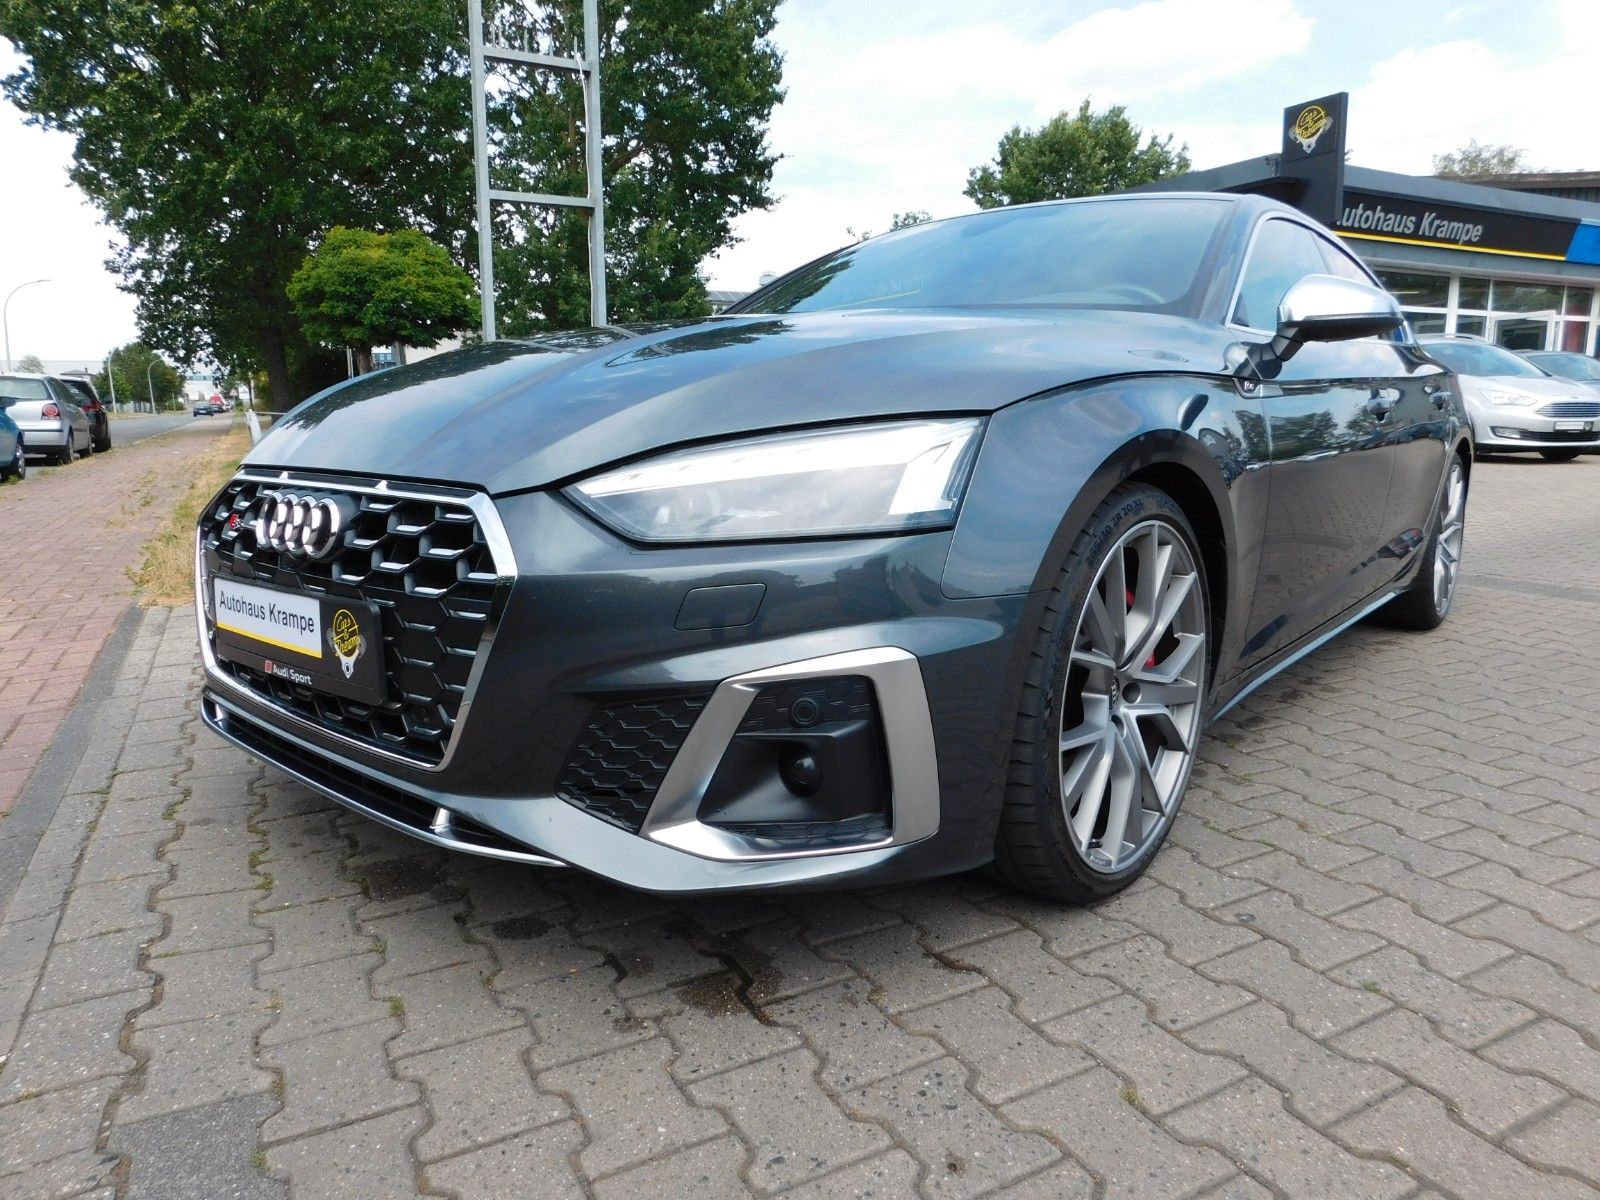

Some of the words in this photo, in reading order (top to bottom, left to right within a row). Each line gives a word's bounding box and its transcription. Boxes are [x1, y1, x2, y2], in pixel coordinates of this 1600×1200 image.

[1336, 203, 1417, 234] utohaus
[1418, 211, 1483, 245] Krampe
[1121, 503, 1133, 516] 20
[219, 590, 266, 621] Autohaus
[268, 602, 315, 636] Krampe
[272, 663, 290, 678] Audi
[289, 668, 313, 685] Sport
